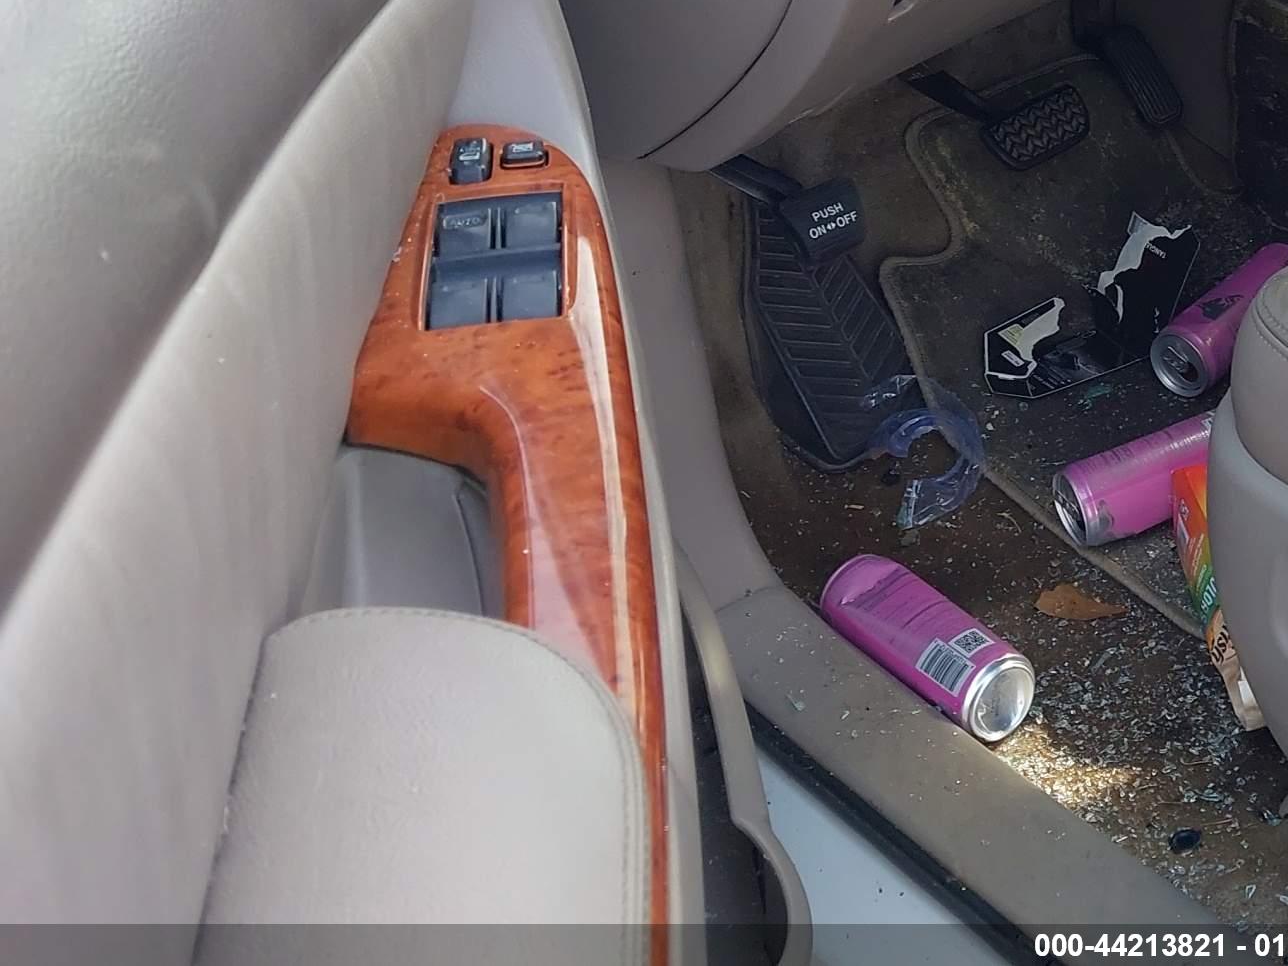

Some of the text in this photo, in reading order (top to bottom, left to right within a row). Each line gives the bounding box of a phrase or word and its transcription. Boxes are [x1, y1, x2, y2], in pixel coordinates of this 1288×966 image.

[811, 202, 844, 222] PUSH
[809, 211, 858, 239] ON OFF
